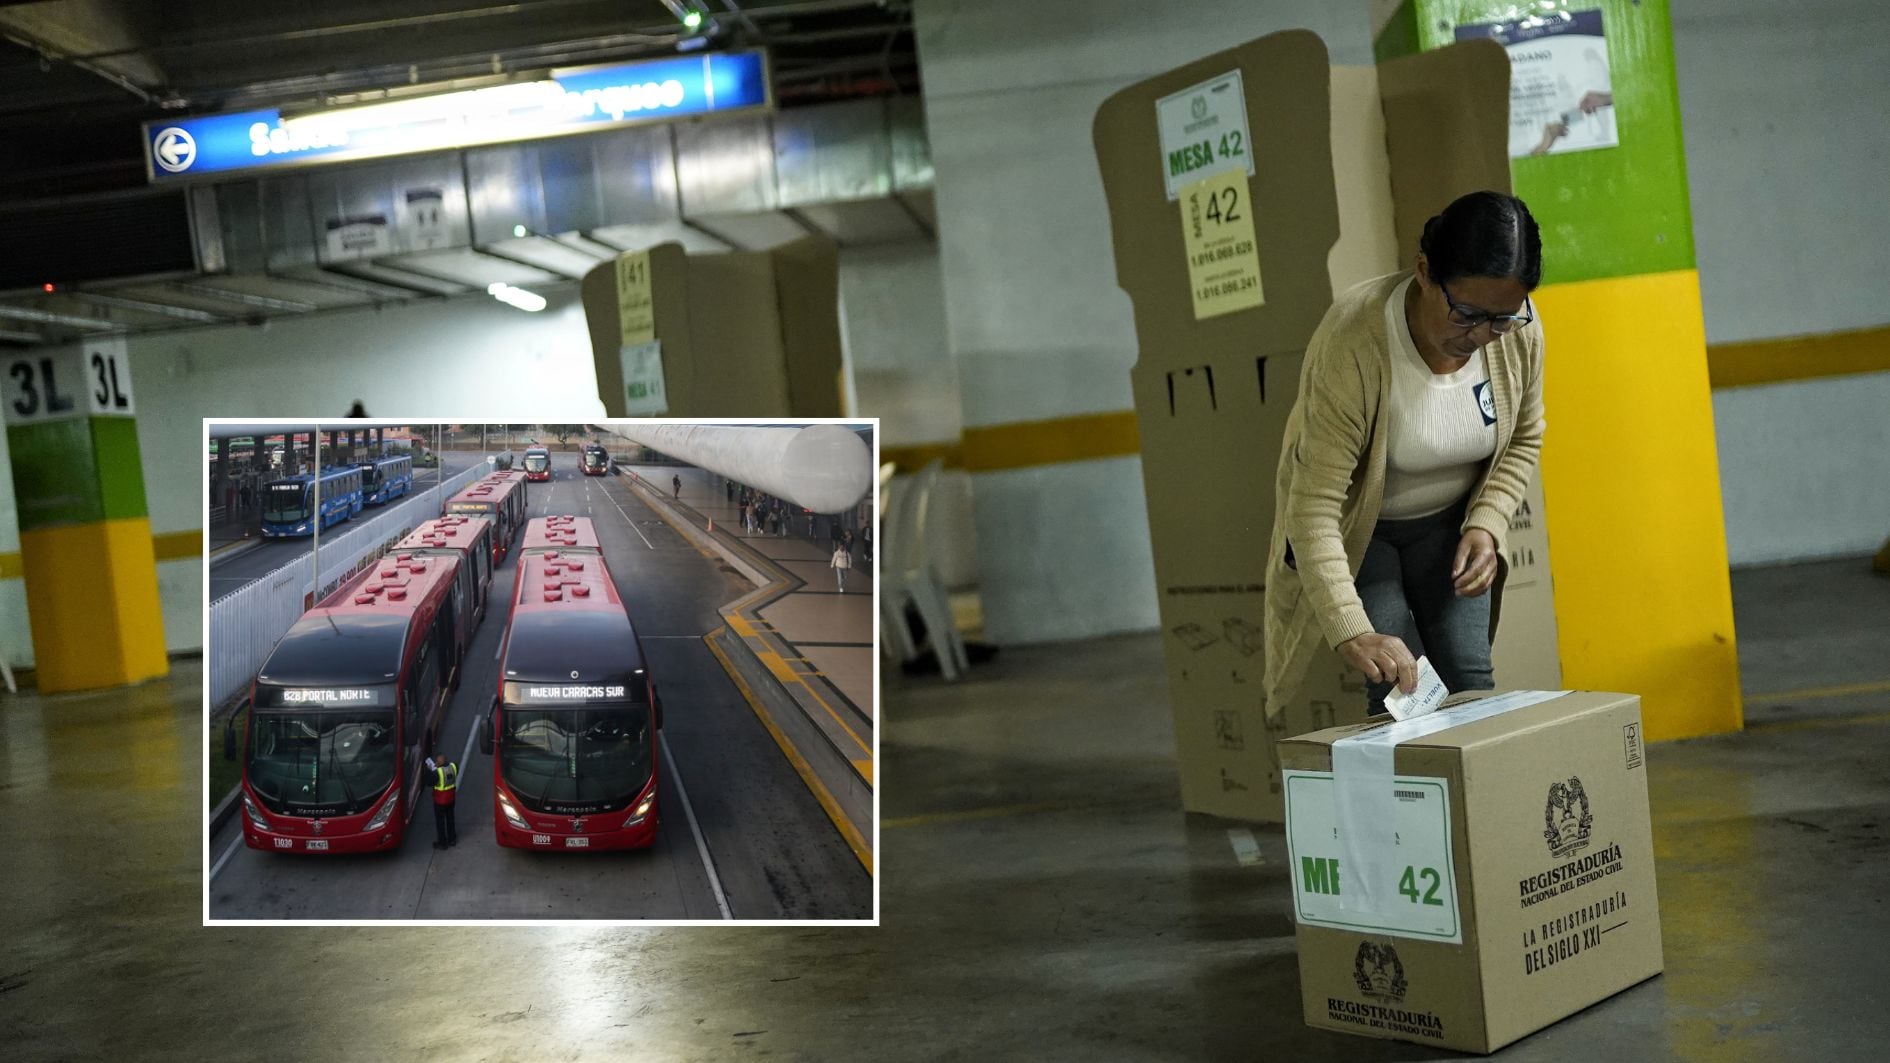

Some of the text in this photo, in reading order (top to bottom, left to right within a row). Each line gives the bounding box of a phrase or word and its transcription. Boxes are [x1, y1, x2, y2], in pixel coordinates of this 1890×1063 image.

[1169, 130, 1244, 177] MESA 42
[1206, 187, 1241, 226] 42
[628, 261, 644, 284] 41
[10, 358, 75, 416] 3L
[92, 352, 128, 407] 3L
[303, 690, 338, 701] PORTAL
[530, 686, 624, 698] NUEVA CARACAS SUR
[1302, 856, 1443, 906] ME 42
[1520, 842, 1622, 896] REGISTRADURÍA
[1520, 861, 1623, 909] NACIONAL DEL ESTADO CIVIL
[1523, 891, 1626, 948] LA REGISTRADURÍA
[1525, 924, 1601, 975] DEL SIGLO XXI
[1328, 998, 1443, 1030] REGISTRADURÍA
[1329, 1011, 1444, 1040] NACIONAL DEL ESTADO CIVIL
